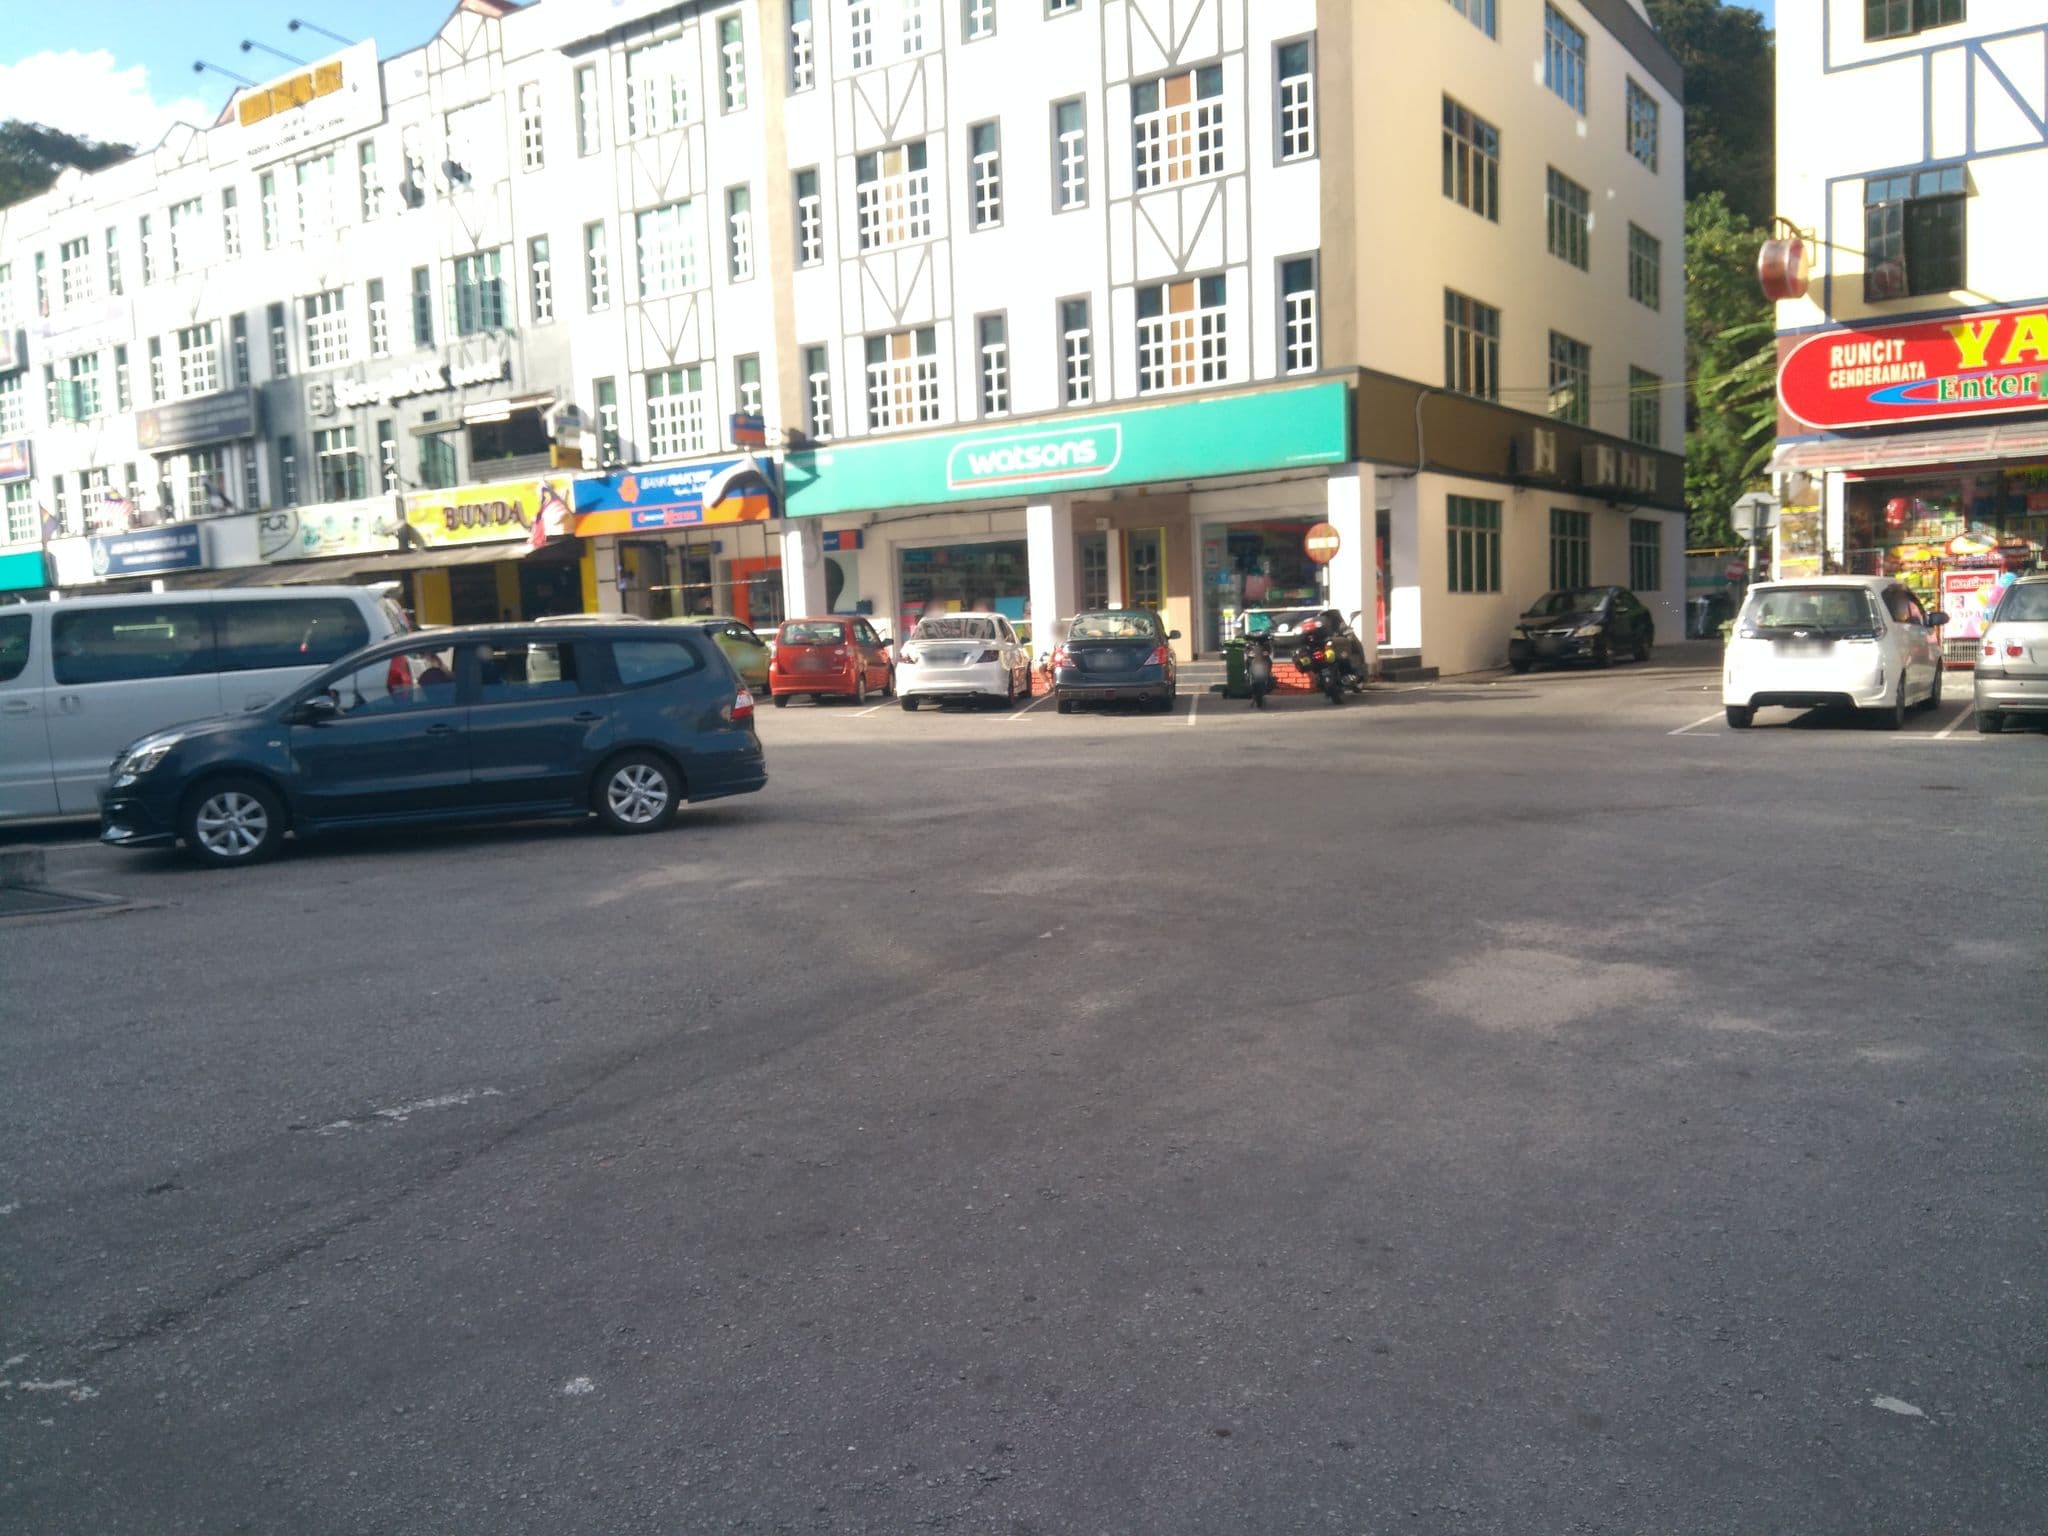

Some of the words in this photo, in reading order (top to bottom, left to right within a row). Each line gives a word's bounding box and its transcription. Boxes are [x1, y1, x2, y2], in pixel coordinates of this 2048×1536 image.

[1830, 339, 1905, 369] RUNCIT
[1829, 361, 1927, 390] CENDERAMATA
[968, 439, 1097, 475] watsons
[443, 500, 532, 531] BUNDA
